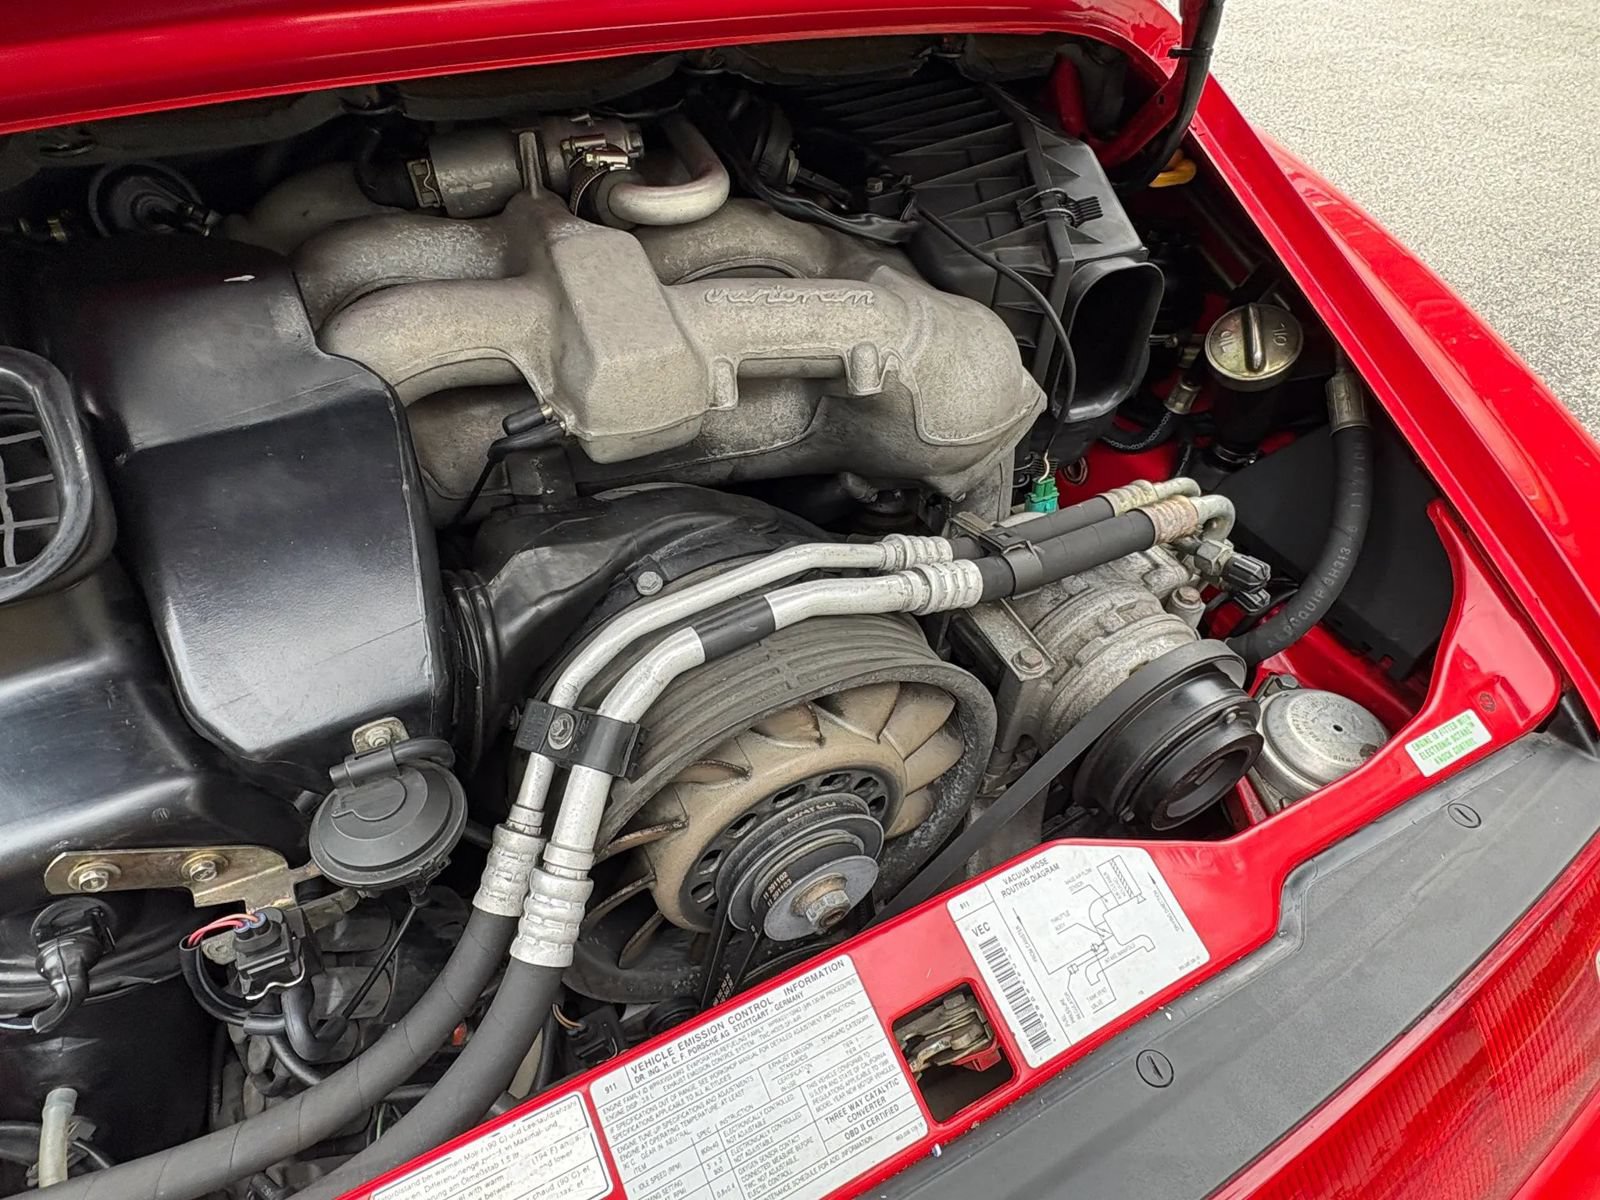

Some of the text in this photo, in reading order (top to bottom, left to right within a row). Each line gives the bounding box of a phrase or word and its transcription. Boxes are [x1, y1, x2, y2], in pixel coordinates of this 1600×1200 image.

[1000, 878, 1031, 898] ROUTING
[1029, 862, 1060, 883] DIAGRAM
[1002, 857, 1048, 886] VACUUM HOSE
[971, 920, 991, 938] VEC
[630, 1046, 674, 1075] VEHICLE
[676, 1020, 725, 1051] EMISSION
[726, 996, 772, 1025] CONTROL
[782, 958, 845, 996] INFORMATION
[686, 1034, 719, 1056] PORSCHE
[718, 1029, 730, 1039] AG
[732, 1008, 770, 1033] STUTTGART
[773, 990, 804, 1011] GERMANY
[603, 1082, 617, 1094] 911
[824, 1076, 900, 1125] THREE WAY CATALYTIC
[615, 1103, 658, 1131] SPECIFICATIONS
[657, 1097, 670, 1108] OUT
[843, 1126, 860, 1140] OBD
[864, 1102, 900, 1128] CERTIFIED
[845, 1095, 887, 1123] CONVERTER
[611, 1114, 655, 1142] SPECIFICATIONS
[616, 1137, 638, 1154] ENGINE
[661, 1101, 705, 1129] SPECIFICATIONS
[618, 1145, 640, 1162] ENGINE
[647, 1123, 680, 1146] OPERATING
